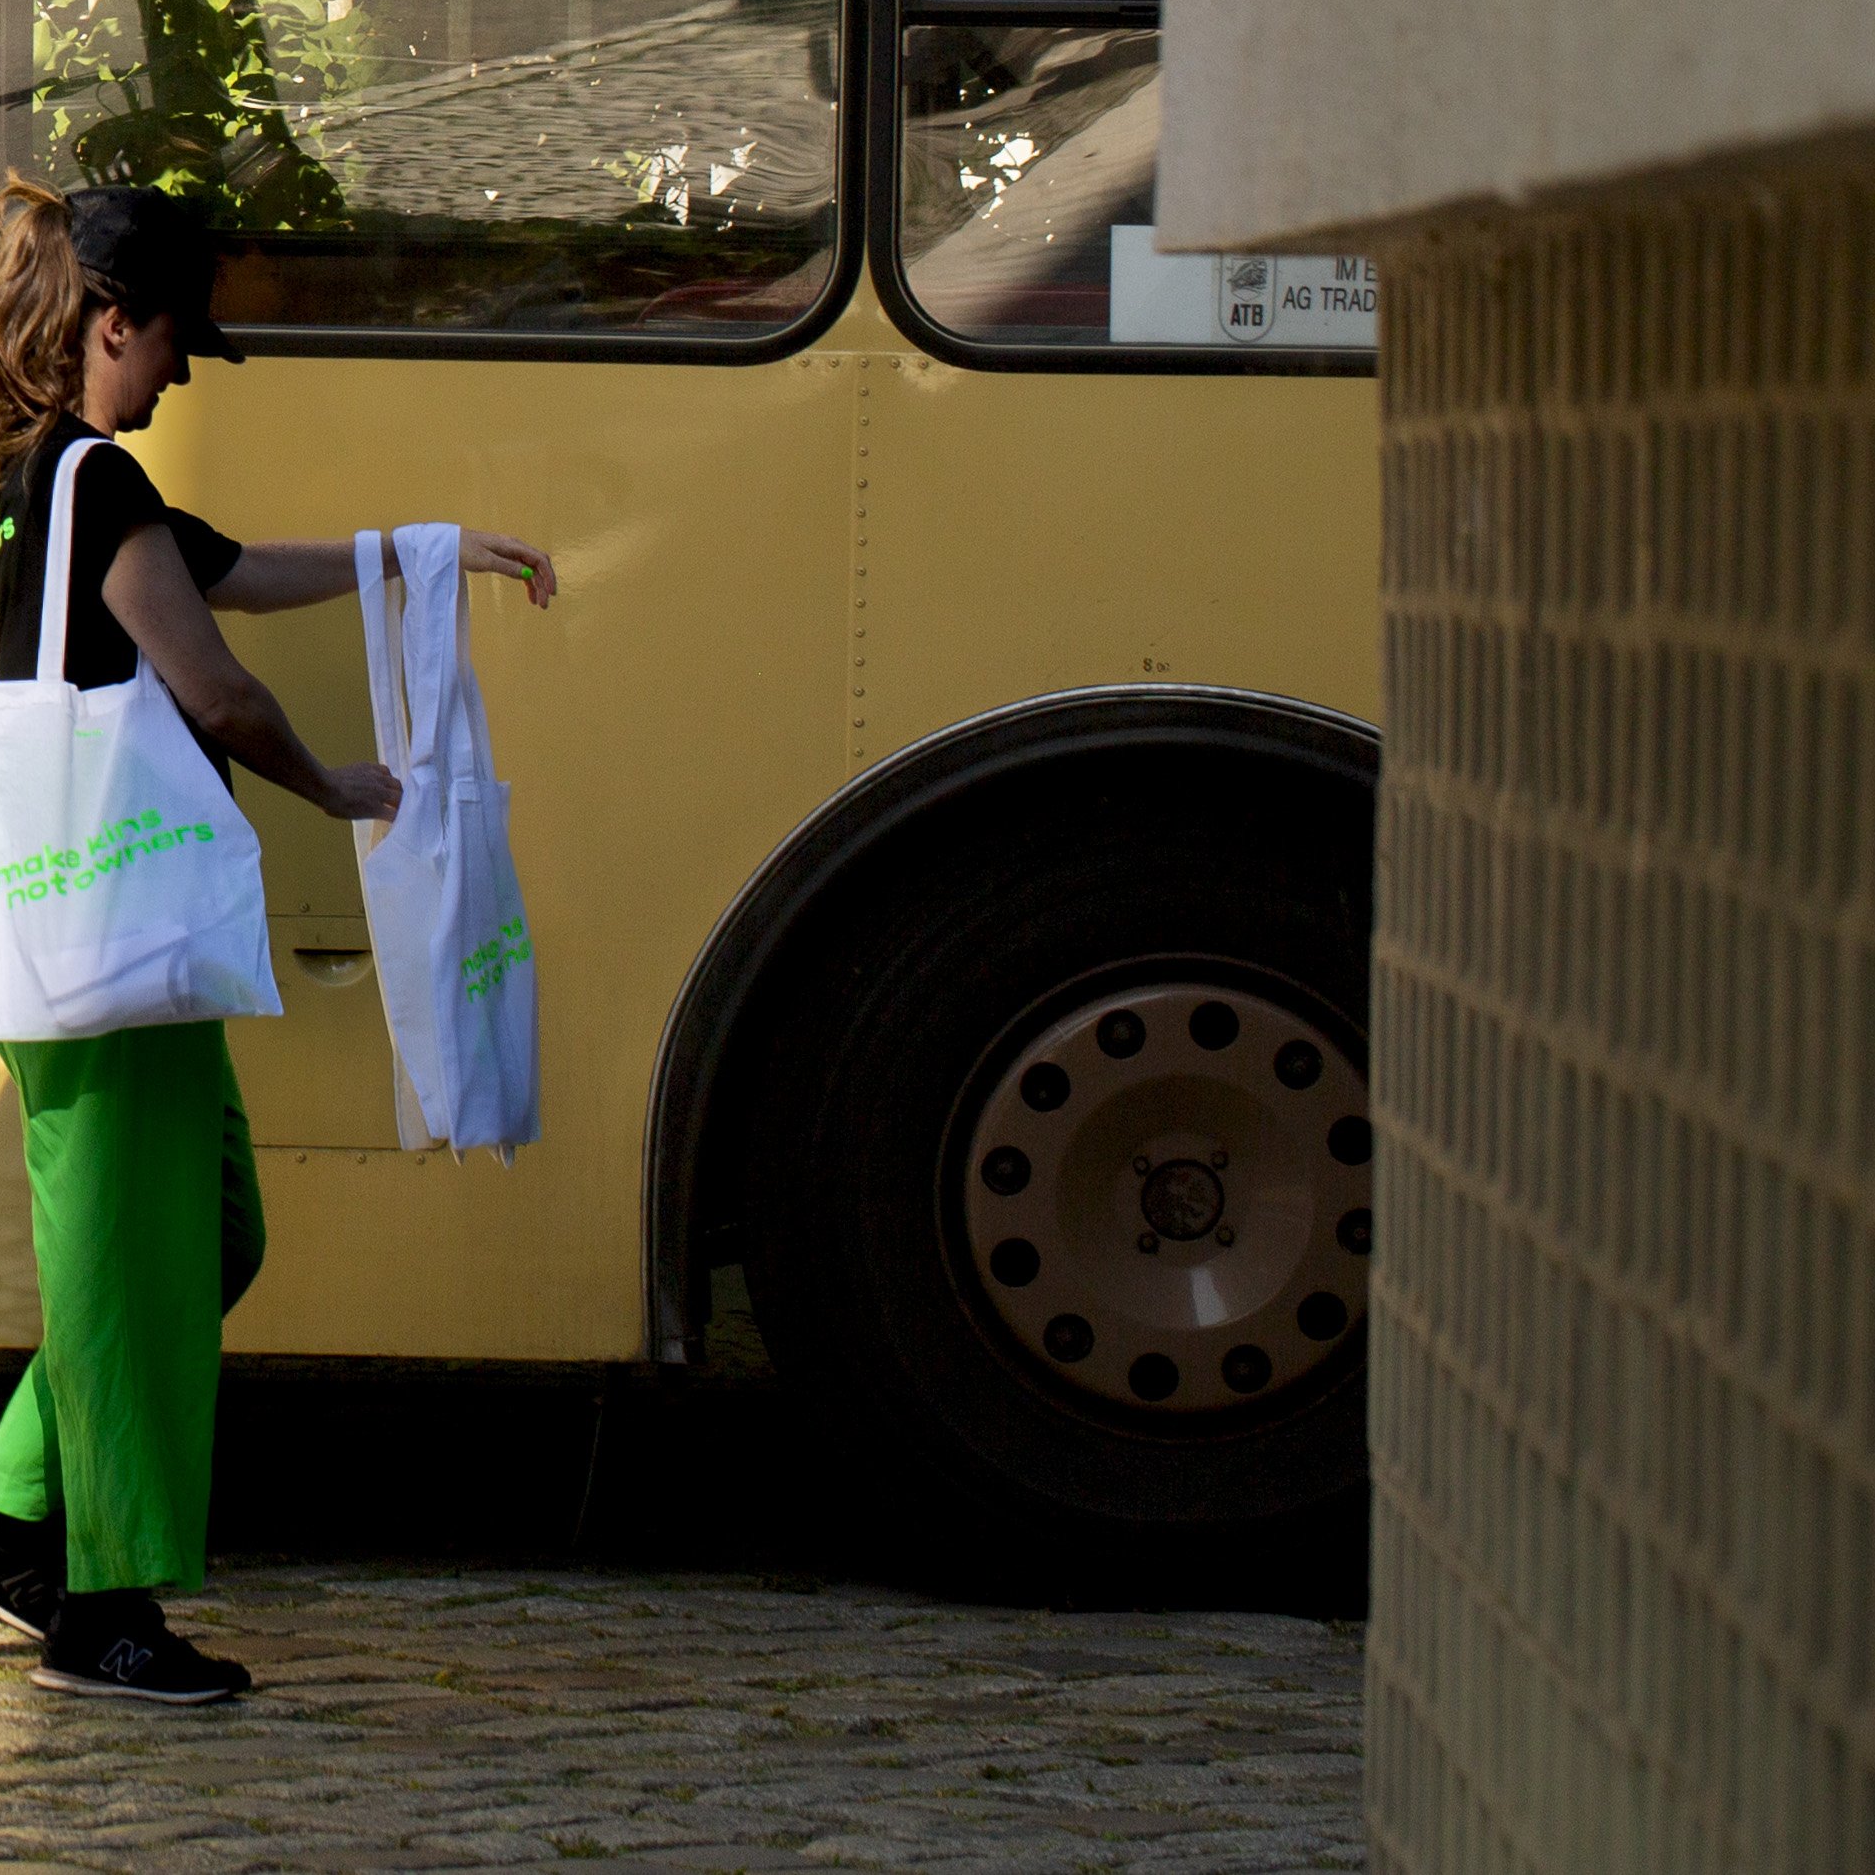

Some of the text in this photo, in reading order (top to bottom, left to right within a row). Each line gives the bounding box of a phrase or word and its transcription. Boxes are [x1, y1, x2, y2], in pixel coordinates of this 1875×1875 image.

[1230, 303, 1264, 326] ATB
[1282, 286, 1312, 311] AG
[85, 808, 163, 857] kins
[6, 822, 215, 910] not owners
